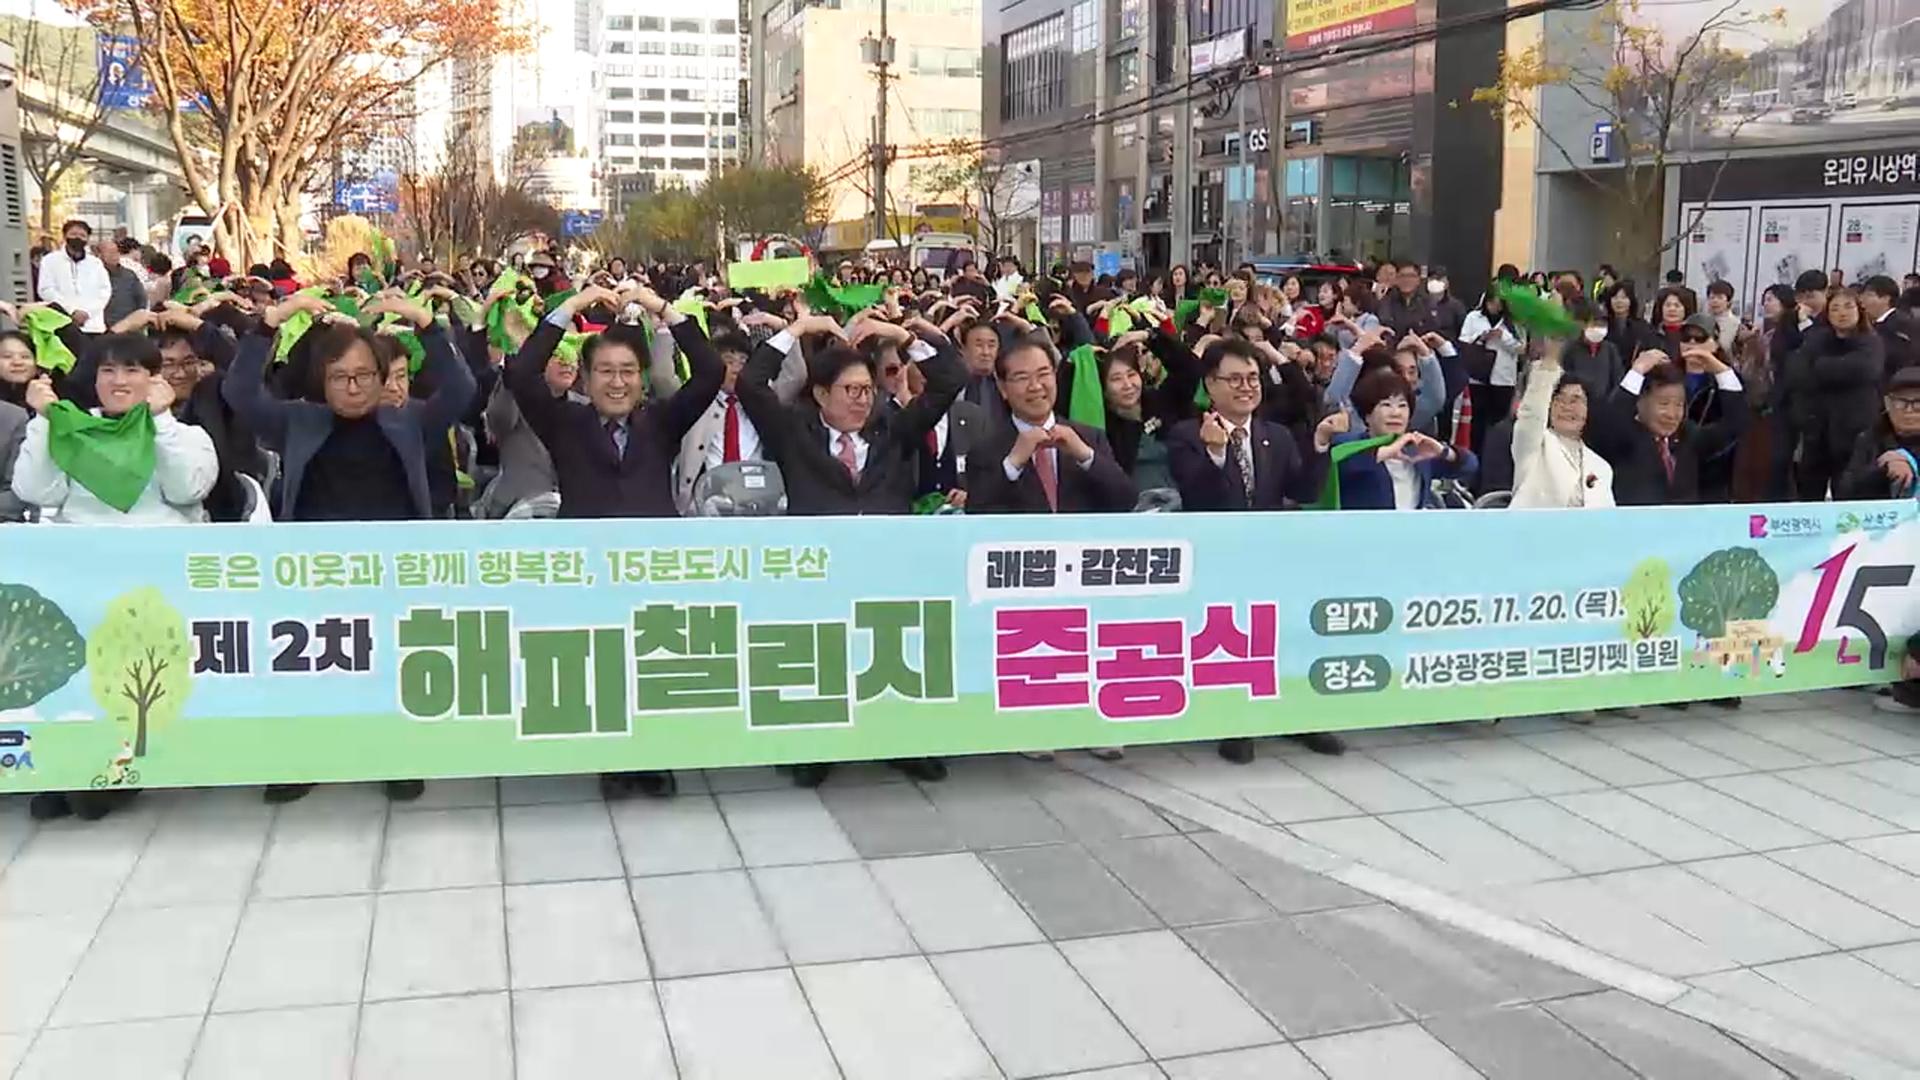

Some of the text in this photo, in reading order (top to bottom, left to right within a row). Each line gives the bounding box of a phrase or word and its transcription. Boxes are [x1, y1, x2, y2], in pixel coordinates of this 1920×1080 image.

[1250, 128, 1270, 152] GS
[1771, 517, 1822, 532] 부산광역시
[187, 547, 828, 589] 좋은 이웃과 함께 행복한, 15분도시 부산
[1325, 589, 1625, 632] 일자 2025. 11. 20. (목).
[192, 599, 1278, 736] 제 2차 해피챌린지 준공식
[1324, 640, 1679, 690] 장소 사상광장로 그린카펫 일원
